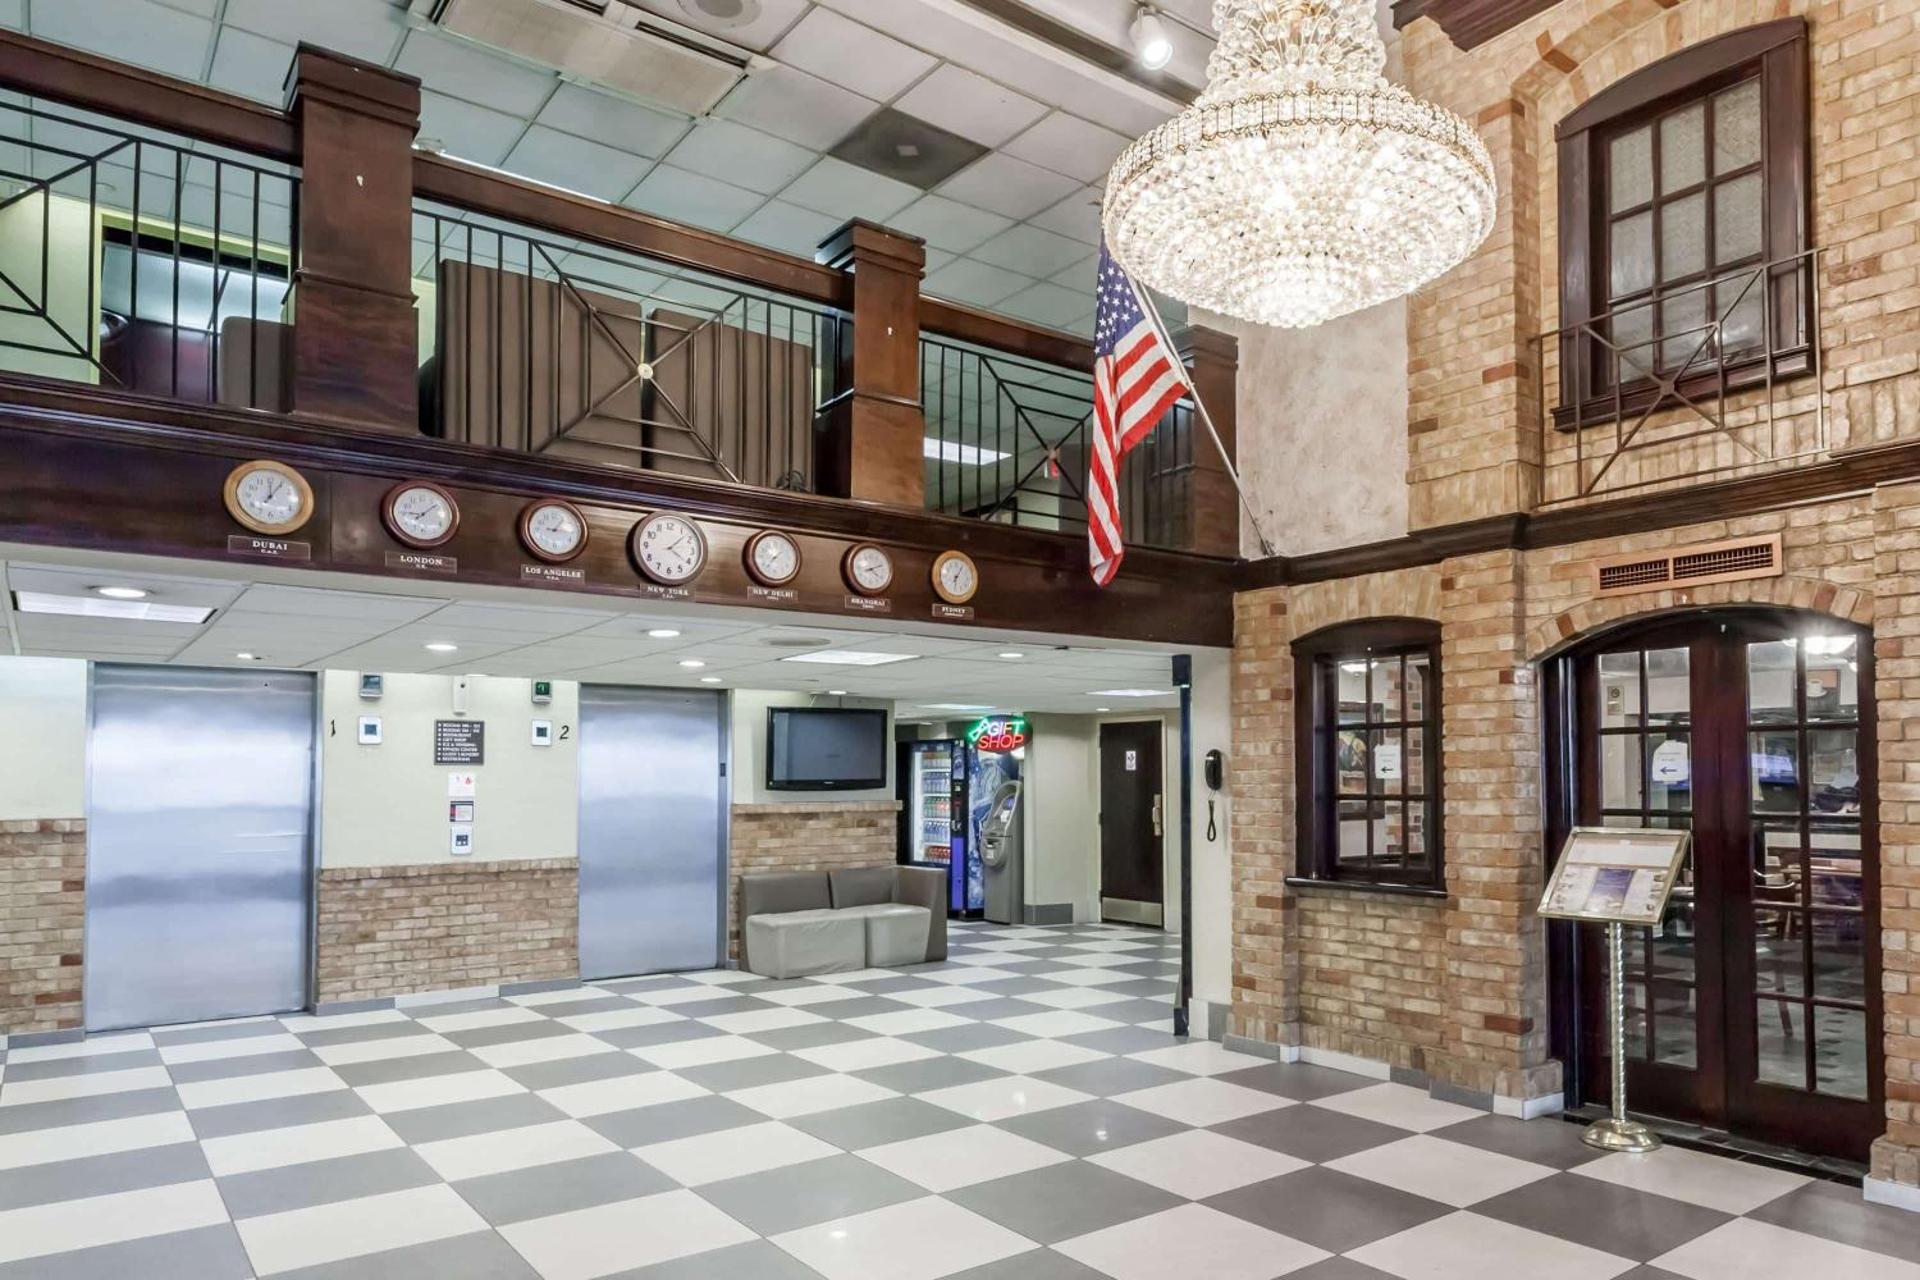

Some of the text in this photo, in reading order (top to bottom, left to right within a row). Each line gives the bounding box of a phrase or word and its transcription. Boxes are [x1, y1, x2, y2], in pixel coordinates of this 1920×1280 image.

[252, 540, 288, 551] DUBAI
[400, 554, 443, 566] LONDON
[525, 566, 541, 574] LOS
[543, 568, 581, 578] ANGELES
[330, 719, 336, 738] 1
[559, 724, 570, 740] 2
[988, 720, 1025, 736] GIFT
[979, 734, 1025, 749] SHOP
